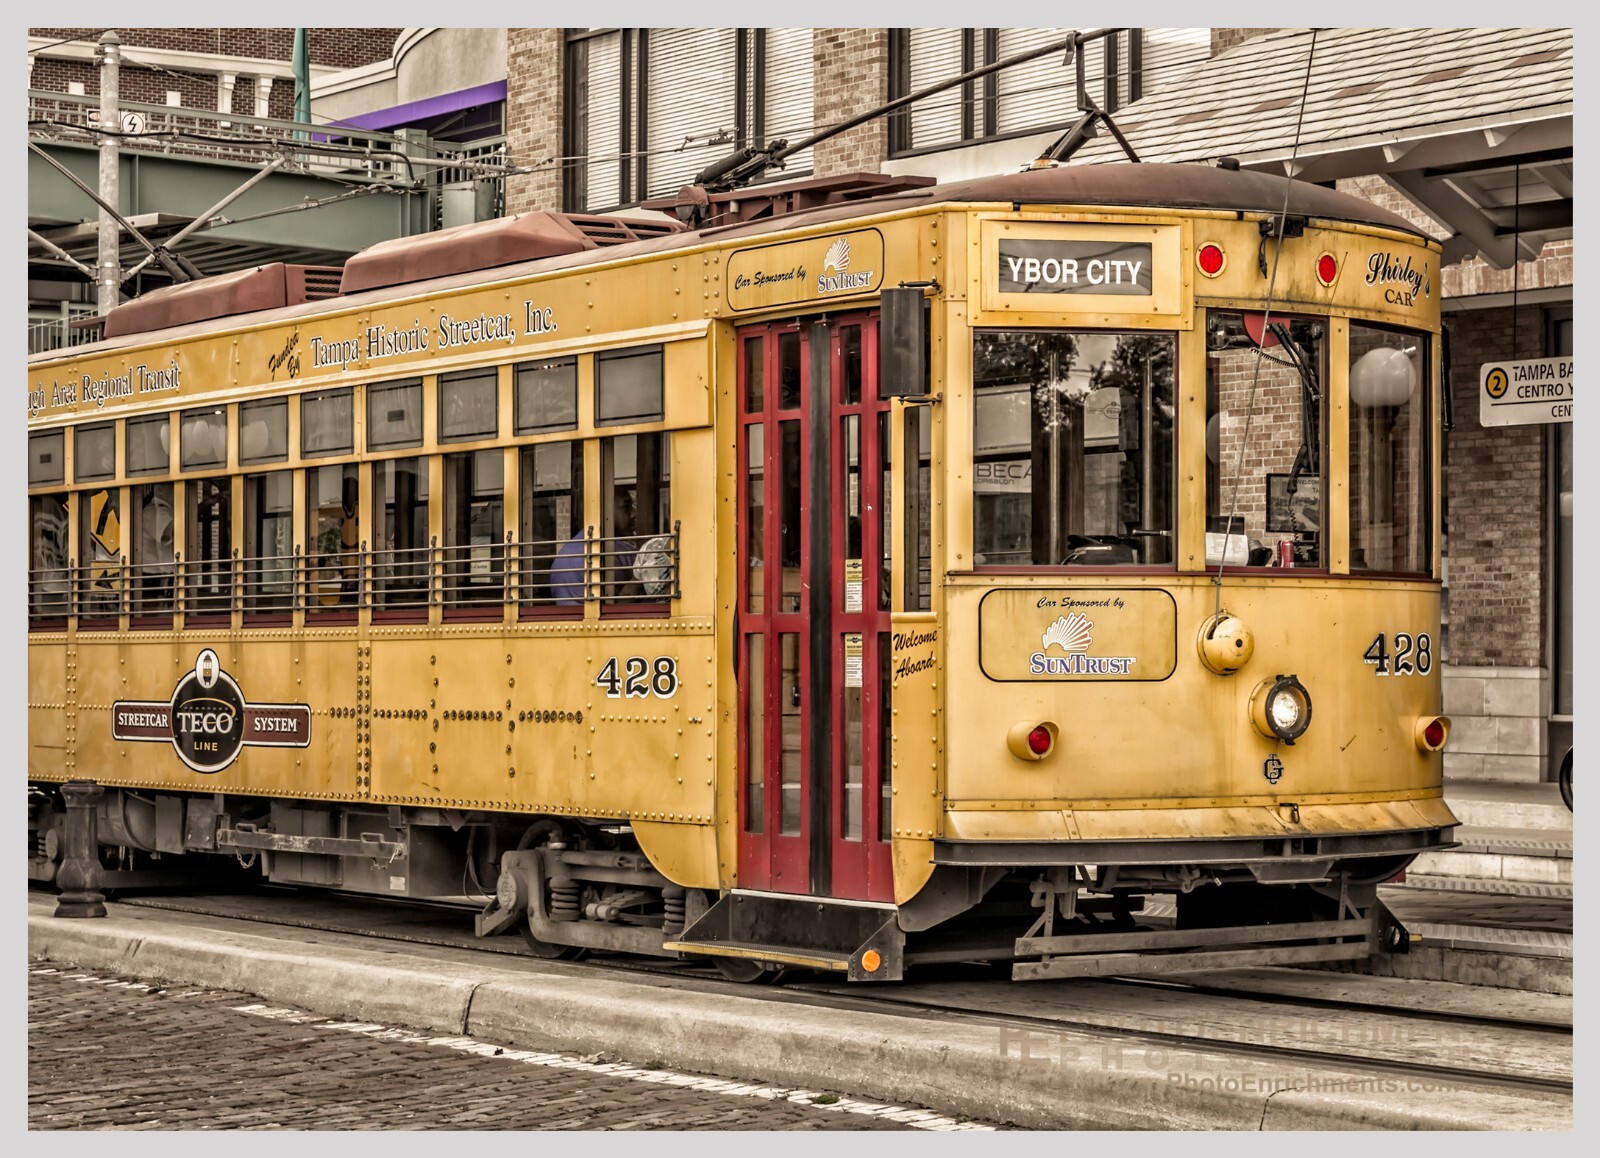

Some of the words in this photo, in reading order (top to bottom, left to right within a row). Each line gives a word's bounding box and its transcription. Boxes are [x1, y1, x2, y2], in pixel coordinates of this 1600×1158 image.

[735, 275, 751, 290] Car
[754, 269, 794, 287] Sponsored
[796, 265, 806, 280] by
[1008, 257, 1079, 284] YBOR
[1086, 259, 1142, 285] CITY
[1365, 252, 1430, 299] Shirley's
[1385, 289, 1413, 307] CAR
[311, 336, 359, 373] Tampa
[365, 319, 429, 358] Historic
[438, 312, 515, 349] Streetcar,
[524, 300, 557, 336] Inc.
[268, 325, 299, 381] Funded
[51, 379, 77, 408] Area
[82, 366, 134, 407] Regional
[137, 359, 180, 393] Transit
[1493, 375, 1501, 392] 2
[1513, 363, 1555, 382] TAMPA
[1517, 383, 1564, 399] CENTRO
[1551, 404, 1573, 418] CEN
[1036, 597, 1056, 609] Car
[1061, 597, 1110, 609] Sponsored
[1113, 597, 1126, 609] by
[893, 630, 938, 652] Welcome
[1363, 632, 1432, 676] 428
[894, 651, 934, 681] Aboard
[596, 656, 679, 699] 428
[118, 712, 169, 728] STREETCAR
[177, 712, 233, 734] TECO
[254, 716, 298, 733] SYSTEM
[194, 741, 218, 751] LINE
